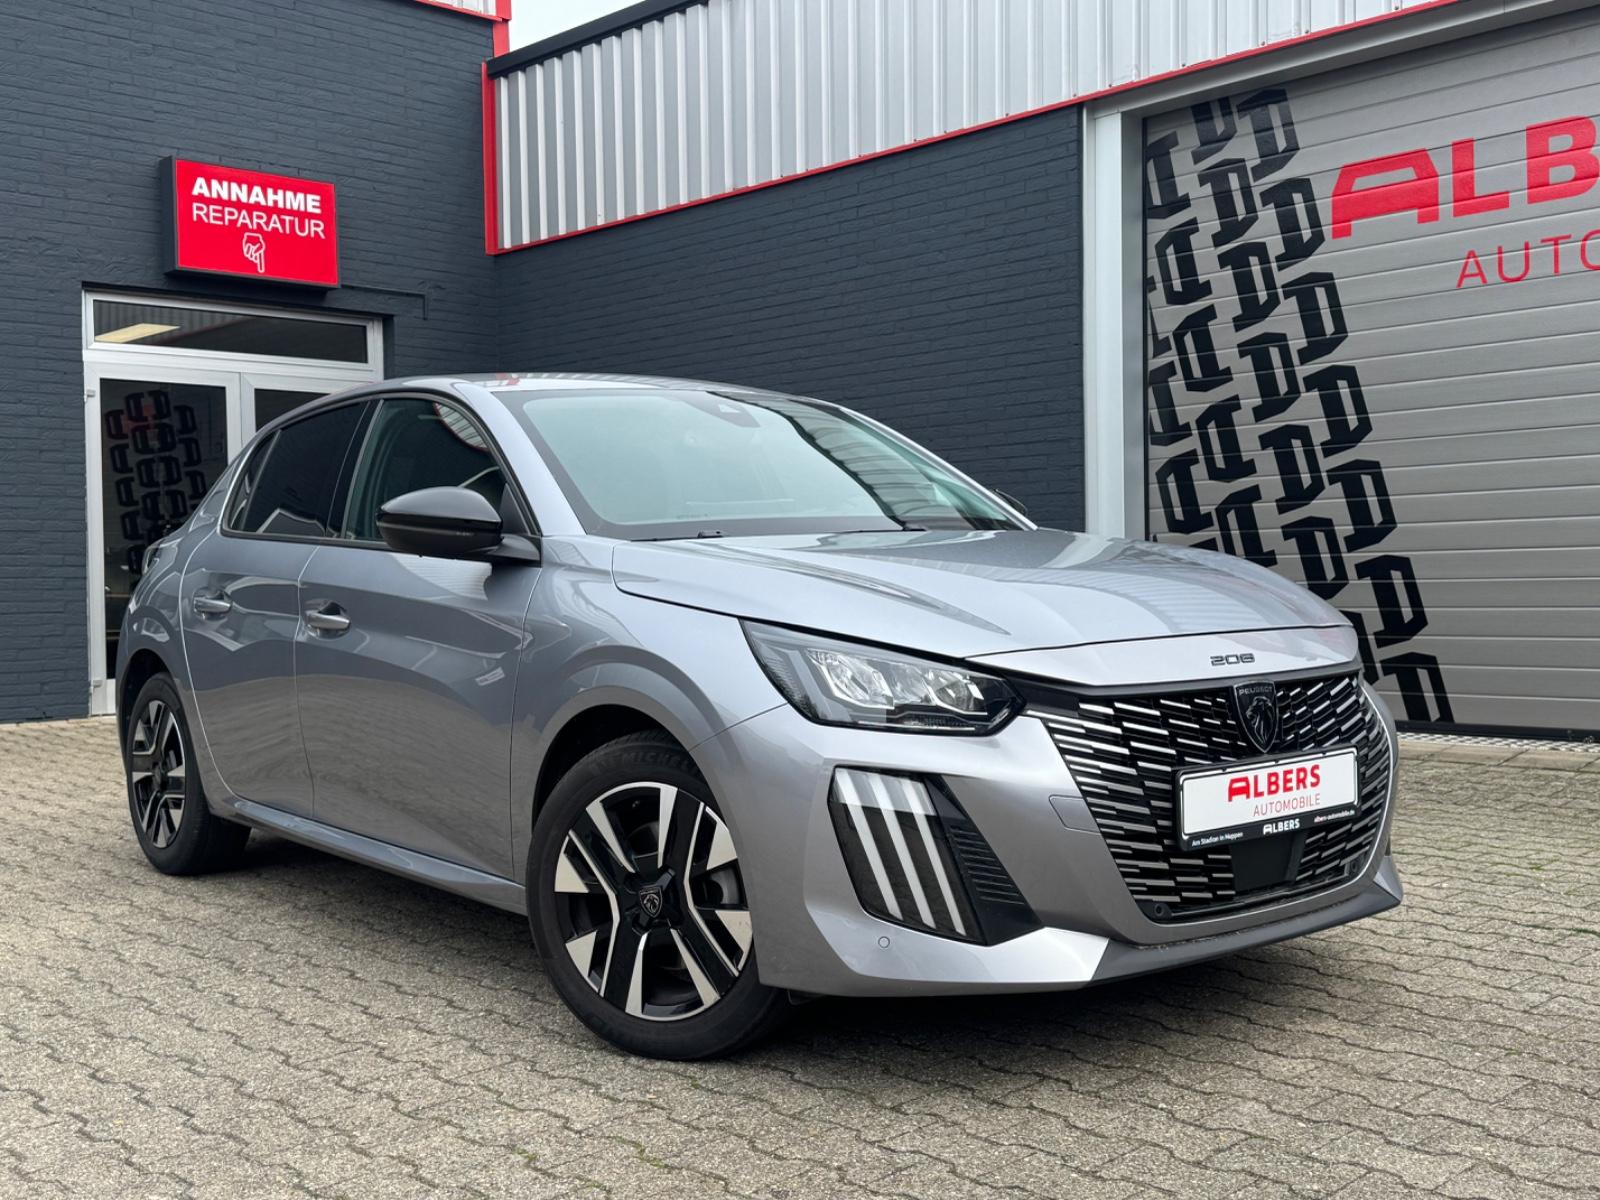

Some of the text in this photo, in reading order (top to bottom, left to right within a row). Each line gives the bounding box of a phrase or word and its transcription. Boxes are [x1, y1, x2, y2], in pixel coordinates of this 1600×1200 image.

[192, 177, 322, 214] ANNAHME
[1331, 115, 1600, 240] ALB
[192, 202, 326, 239] REPARATUR
[1210, 653, 1255, 666] 208
[1227, 764, 1321, 802] ALBERS
[1253, 793, 1321, 817] AUTOMOBILE
[1262, 818, 1300, 835] ALBERS
